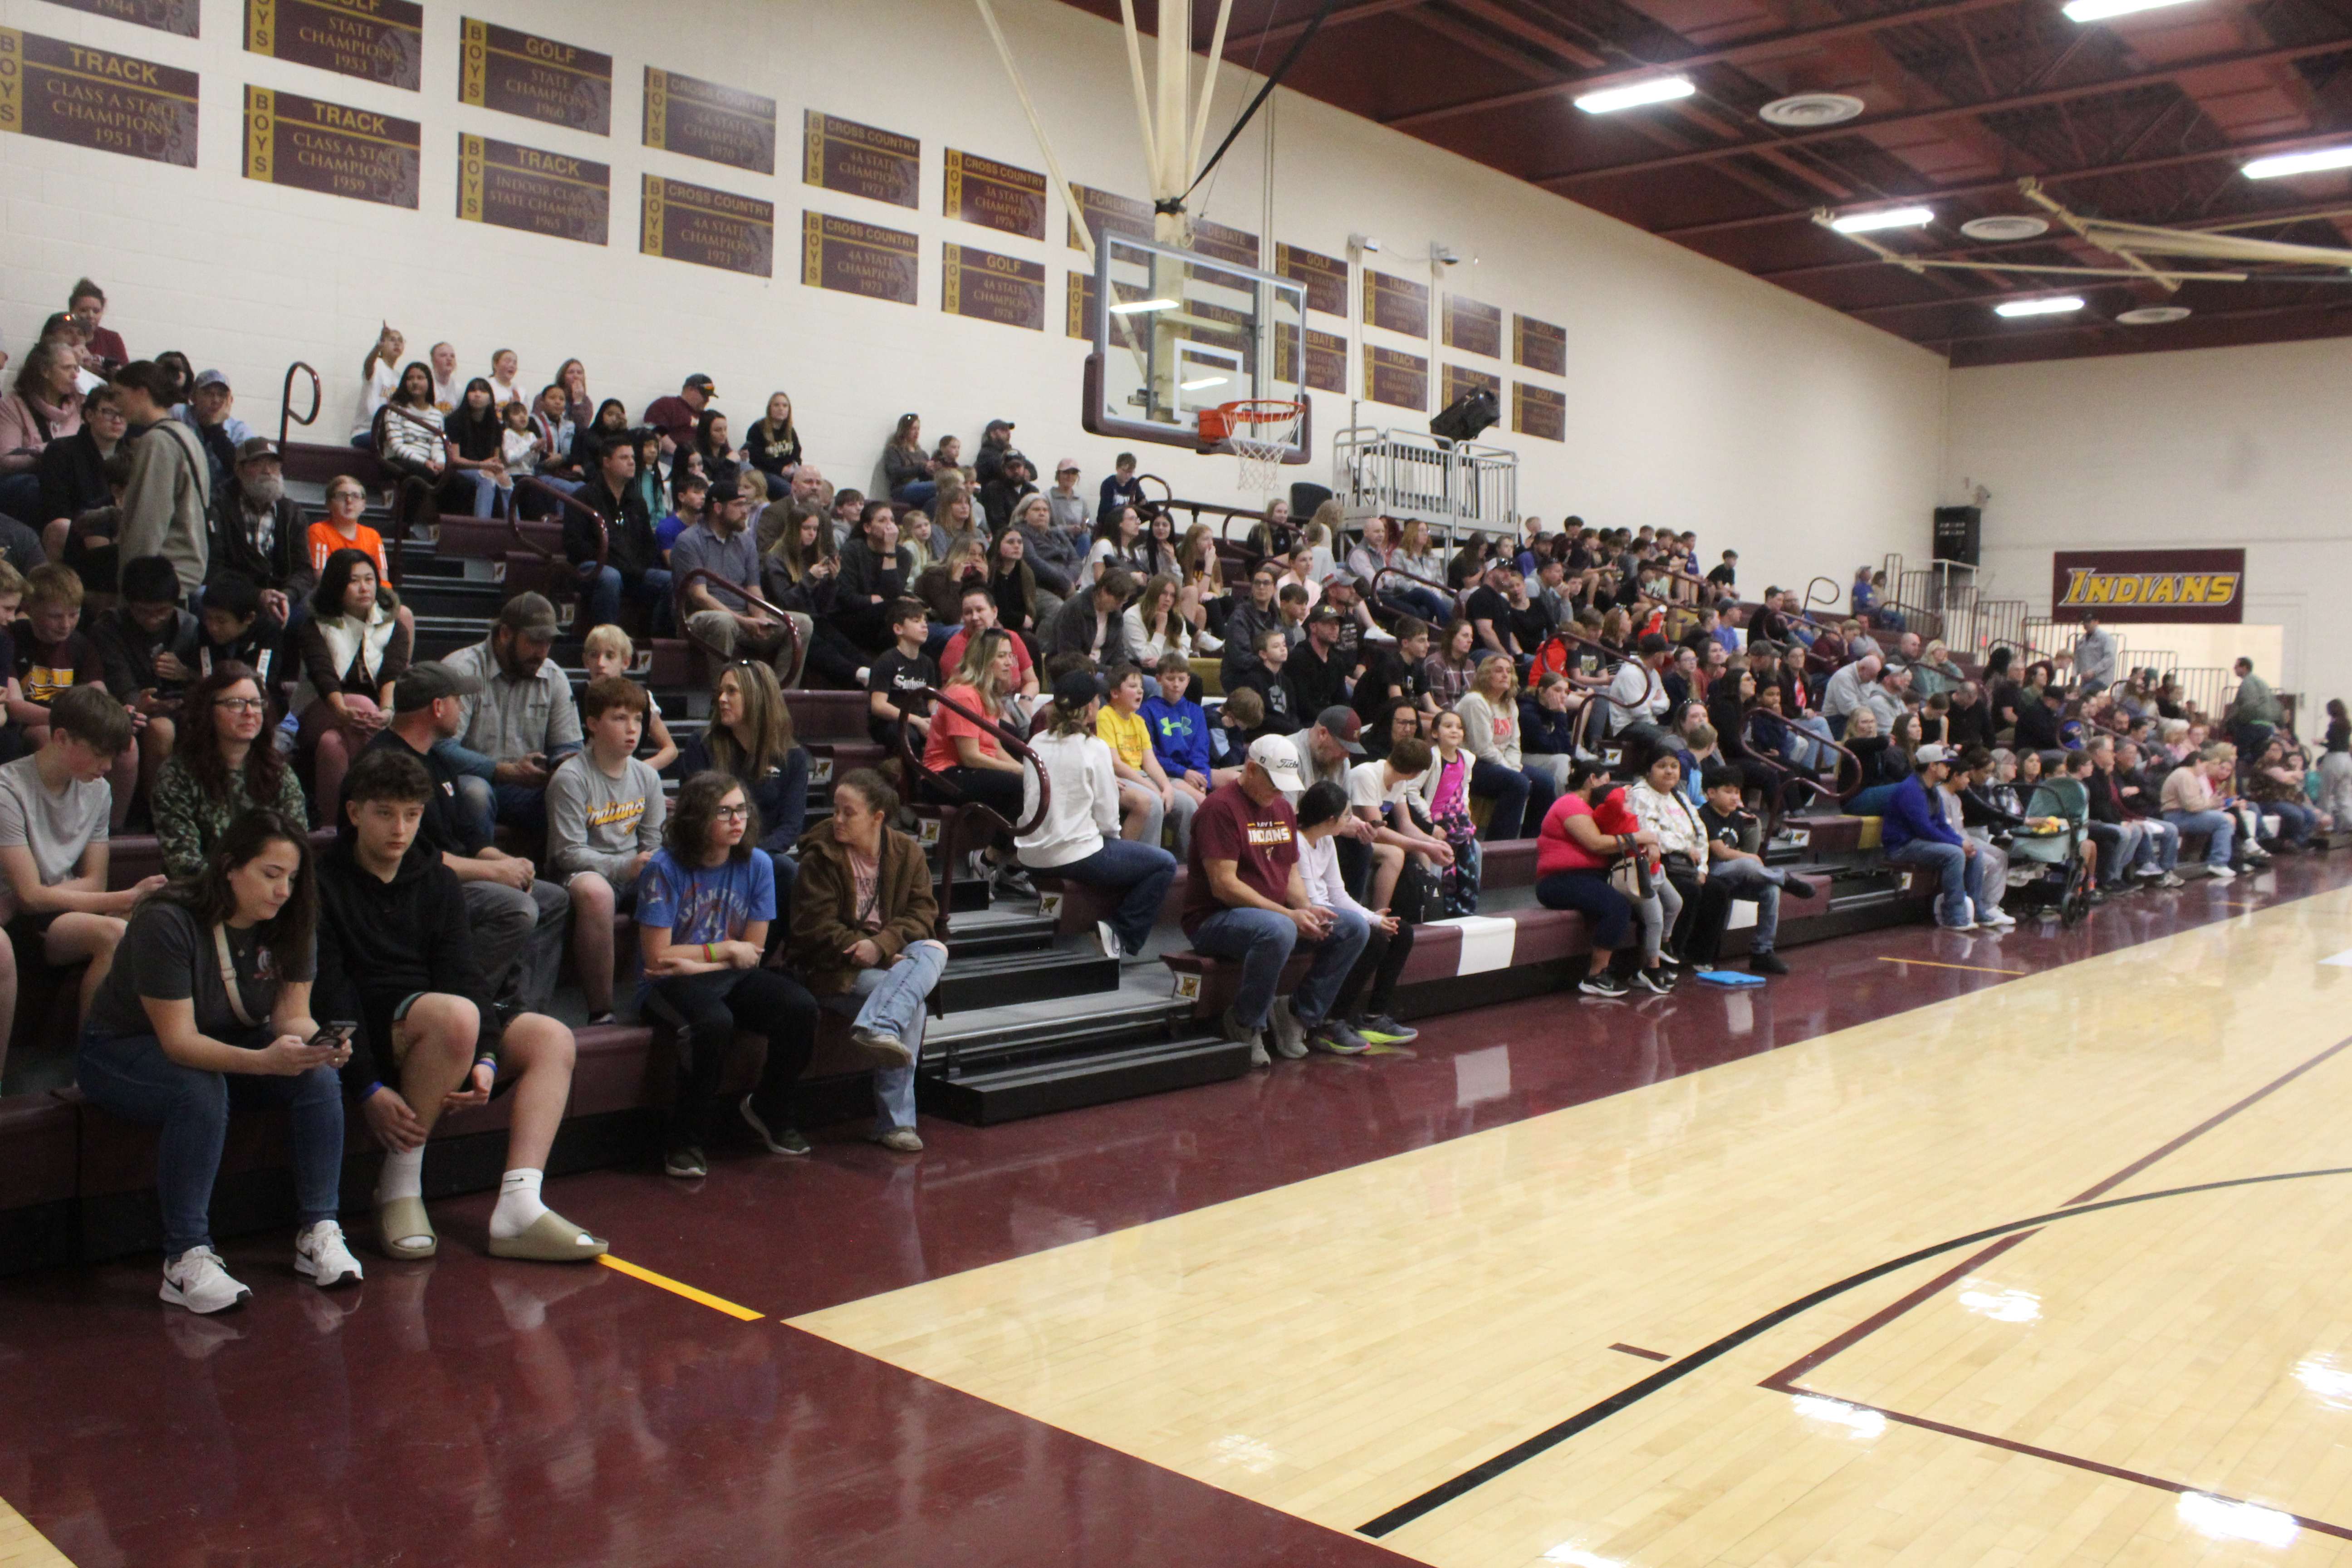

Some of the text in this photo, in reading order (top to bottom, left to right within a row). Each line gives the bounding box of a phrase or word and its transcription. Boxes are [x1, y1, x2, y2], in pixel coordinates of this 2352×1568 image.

[299, 26, 402, 63] CHAMPIONS
[329, 16, 374, 39] STATE
[70, 47, 157, 85] TRACK
[334, 52, 368, 71] 1953
[468, 23, 481, 98] BOYS
[525, 36, 576, 66] GOLF
[47, 79, 176, 121] CLASS A STATE
[52, 99, 172, 136] CHAMPIONS
[651, 73, 663, 142] BOYS
[254, 93, 269, 173] BOYS
[311, 102, 387, 135] TRACK
[828, 119, 916, 153] CROSS COUNTRY
[95, 127, 132, 148] 1951
[293, 132, 341, 154] CLASS
[346, 144, 356, 156] A
[810, 116, 820, 180] BOYS
[298, 150, 398, 182] CHAMPIONS
[466, 141, 480, 214] BOYS
[516, 147, 580, 177] TRACK
[966, 156, 1043, 188] CROSS COUNTRY
[668, 184, 769, 217] CROSS COUNTRY
[950, 153, 960, 214] BOYS
[648, 181, 660, 249] BOYS
[808, 216, 818, 280] BOYS
[826, 219, 914, 248] CROSS COUNTRY
[948, 247, 957, 308] BOYS
[986, 253, 1021, 274] GOLF
[1072, 276, 1080, 332] BOYS
[1306, 330, 1336, 348] EBATE
[2060, 569, 2239, 606] INDIANS
[587, 797, 646, 828] Indians
